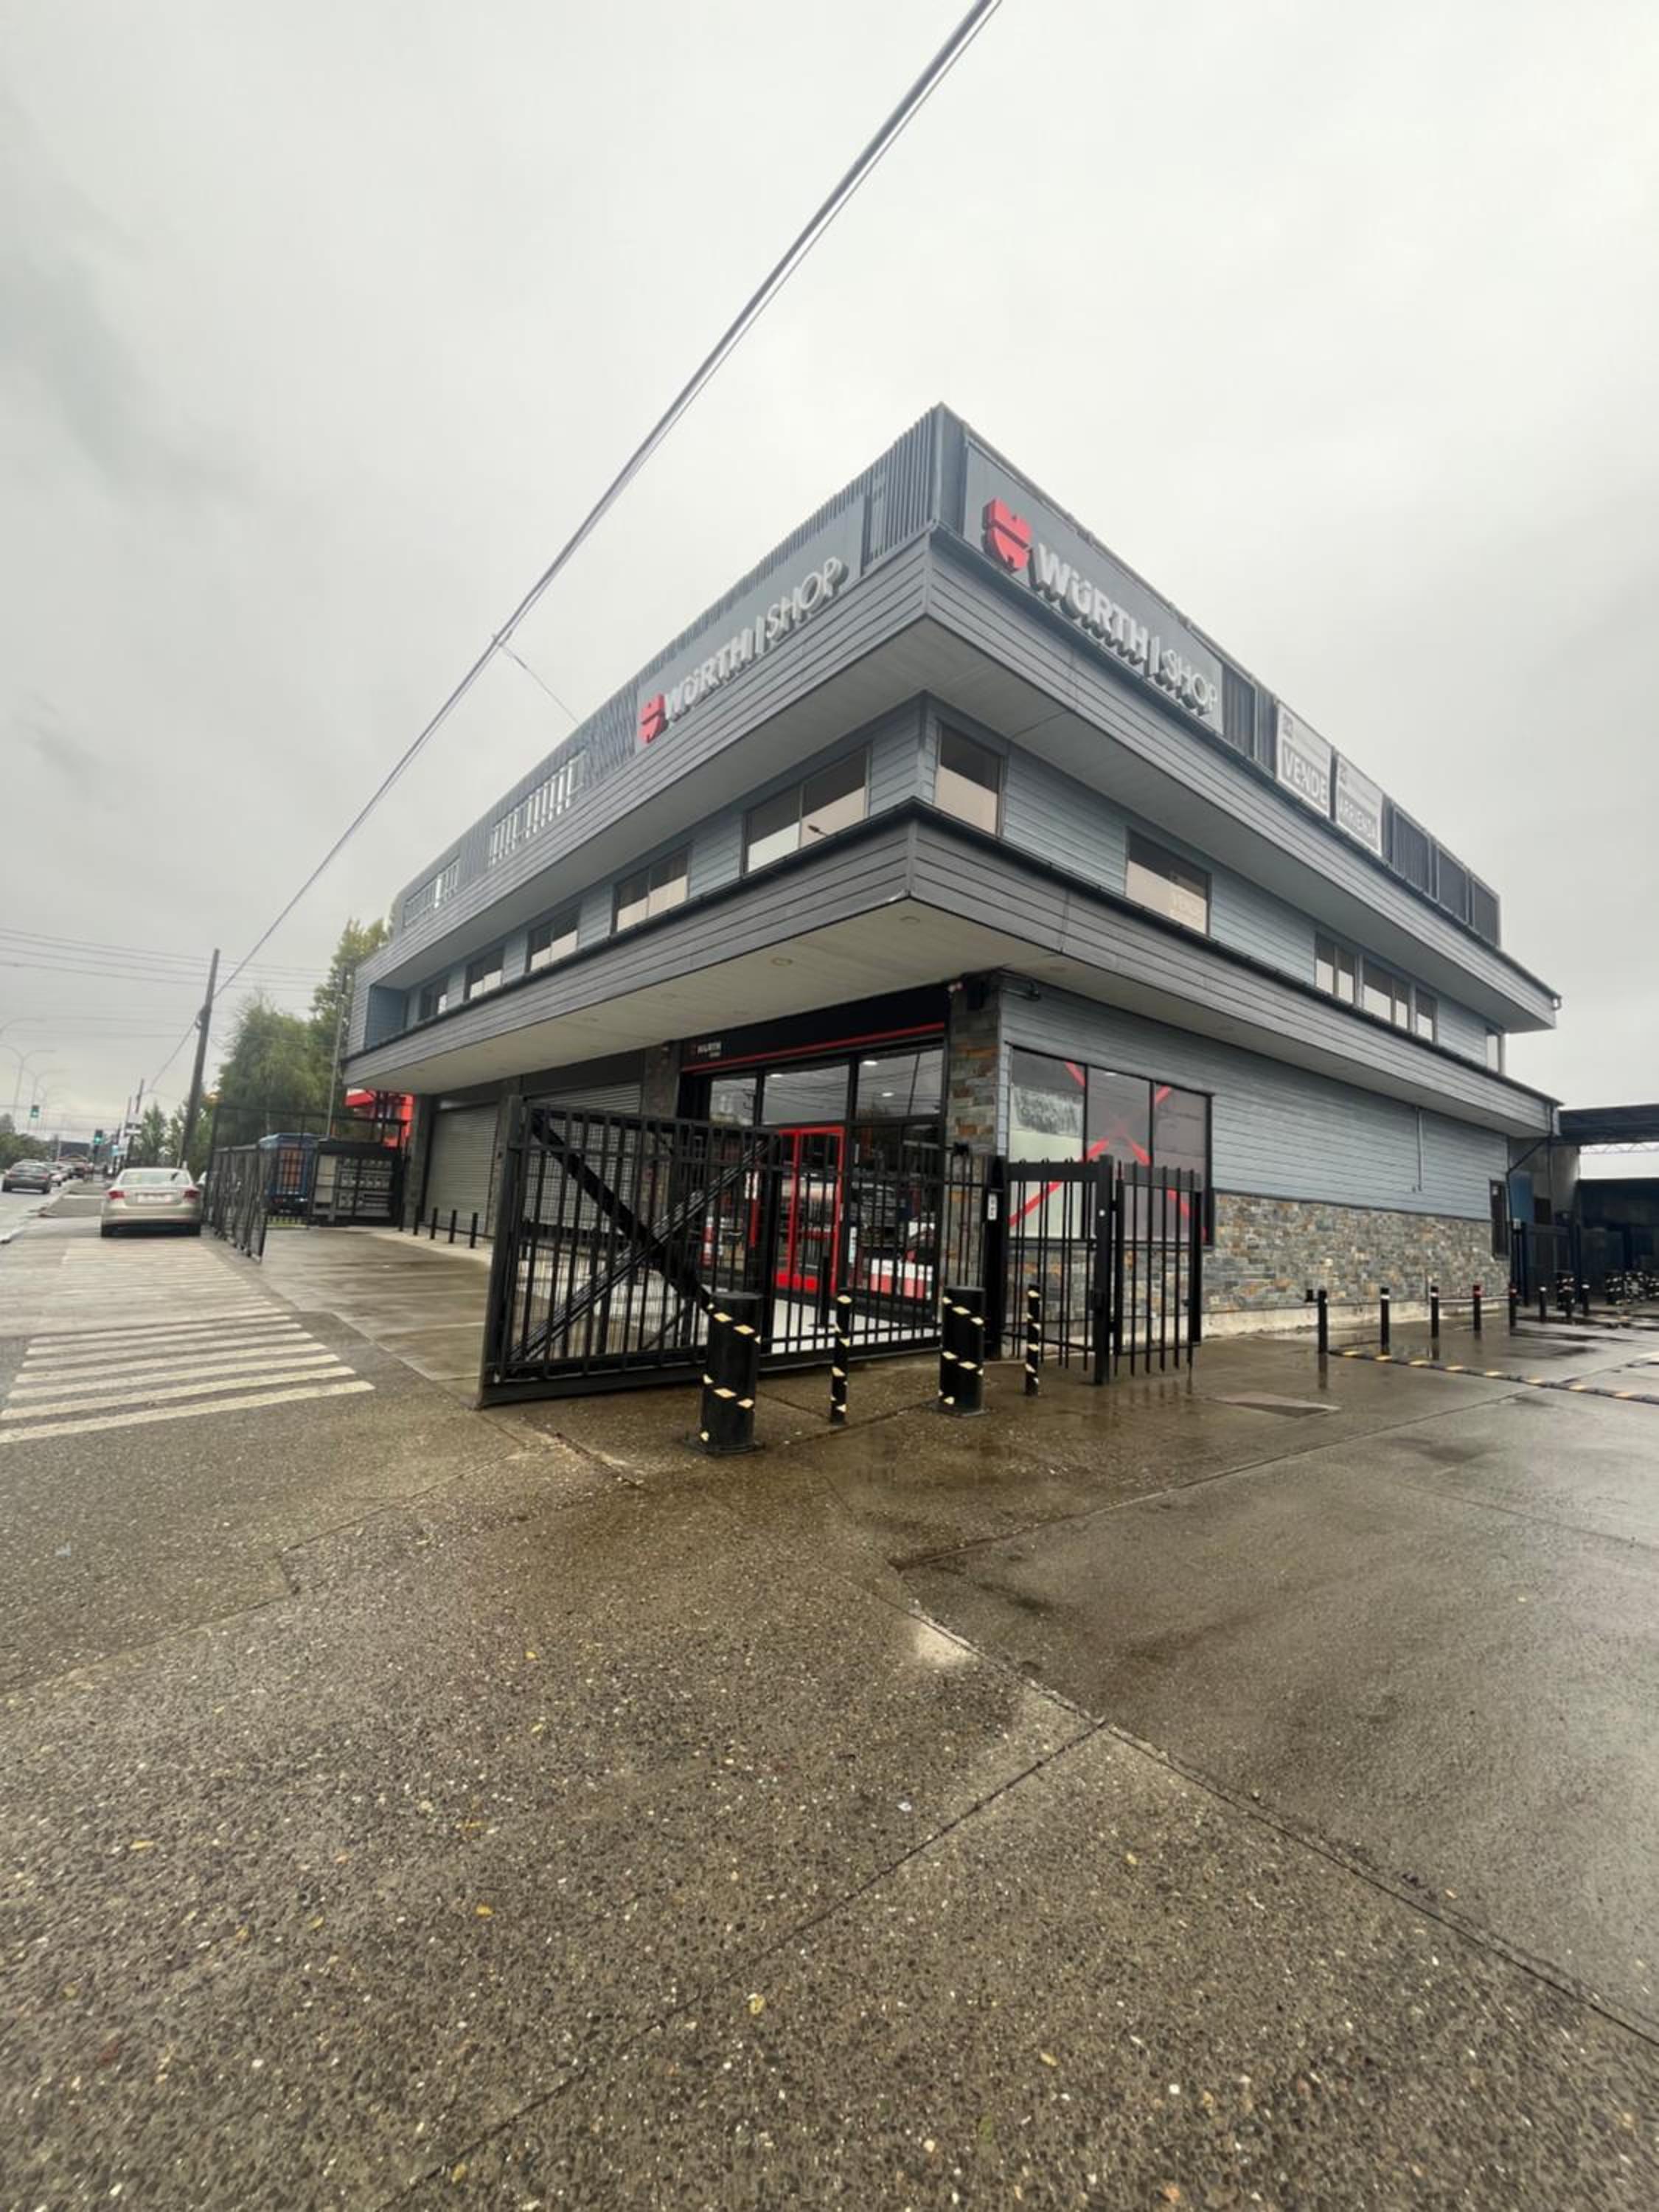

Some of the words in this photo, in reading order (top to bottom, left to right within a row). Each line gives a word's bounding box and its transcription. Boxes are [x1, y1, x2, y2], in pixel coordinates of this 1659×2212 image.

[765, 556, 846, 640] SHOP
[1034, 542, 1149, 664] WÜRTH
[1160, 649, 1217, 715] SHOP
[1284, 745, 1328, 804] VENDE
